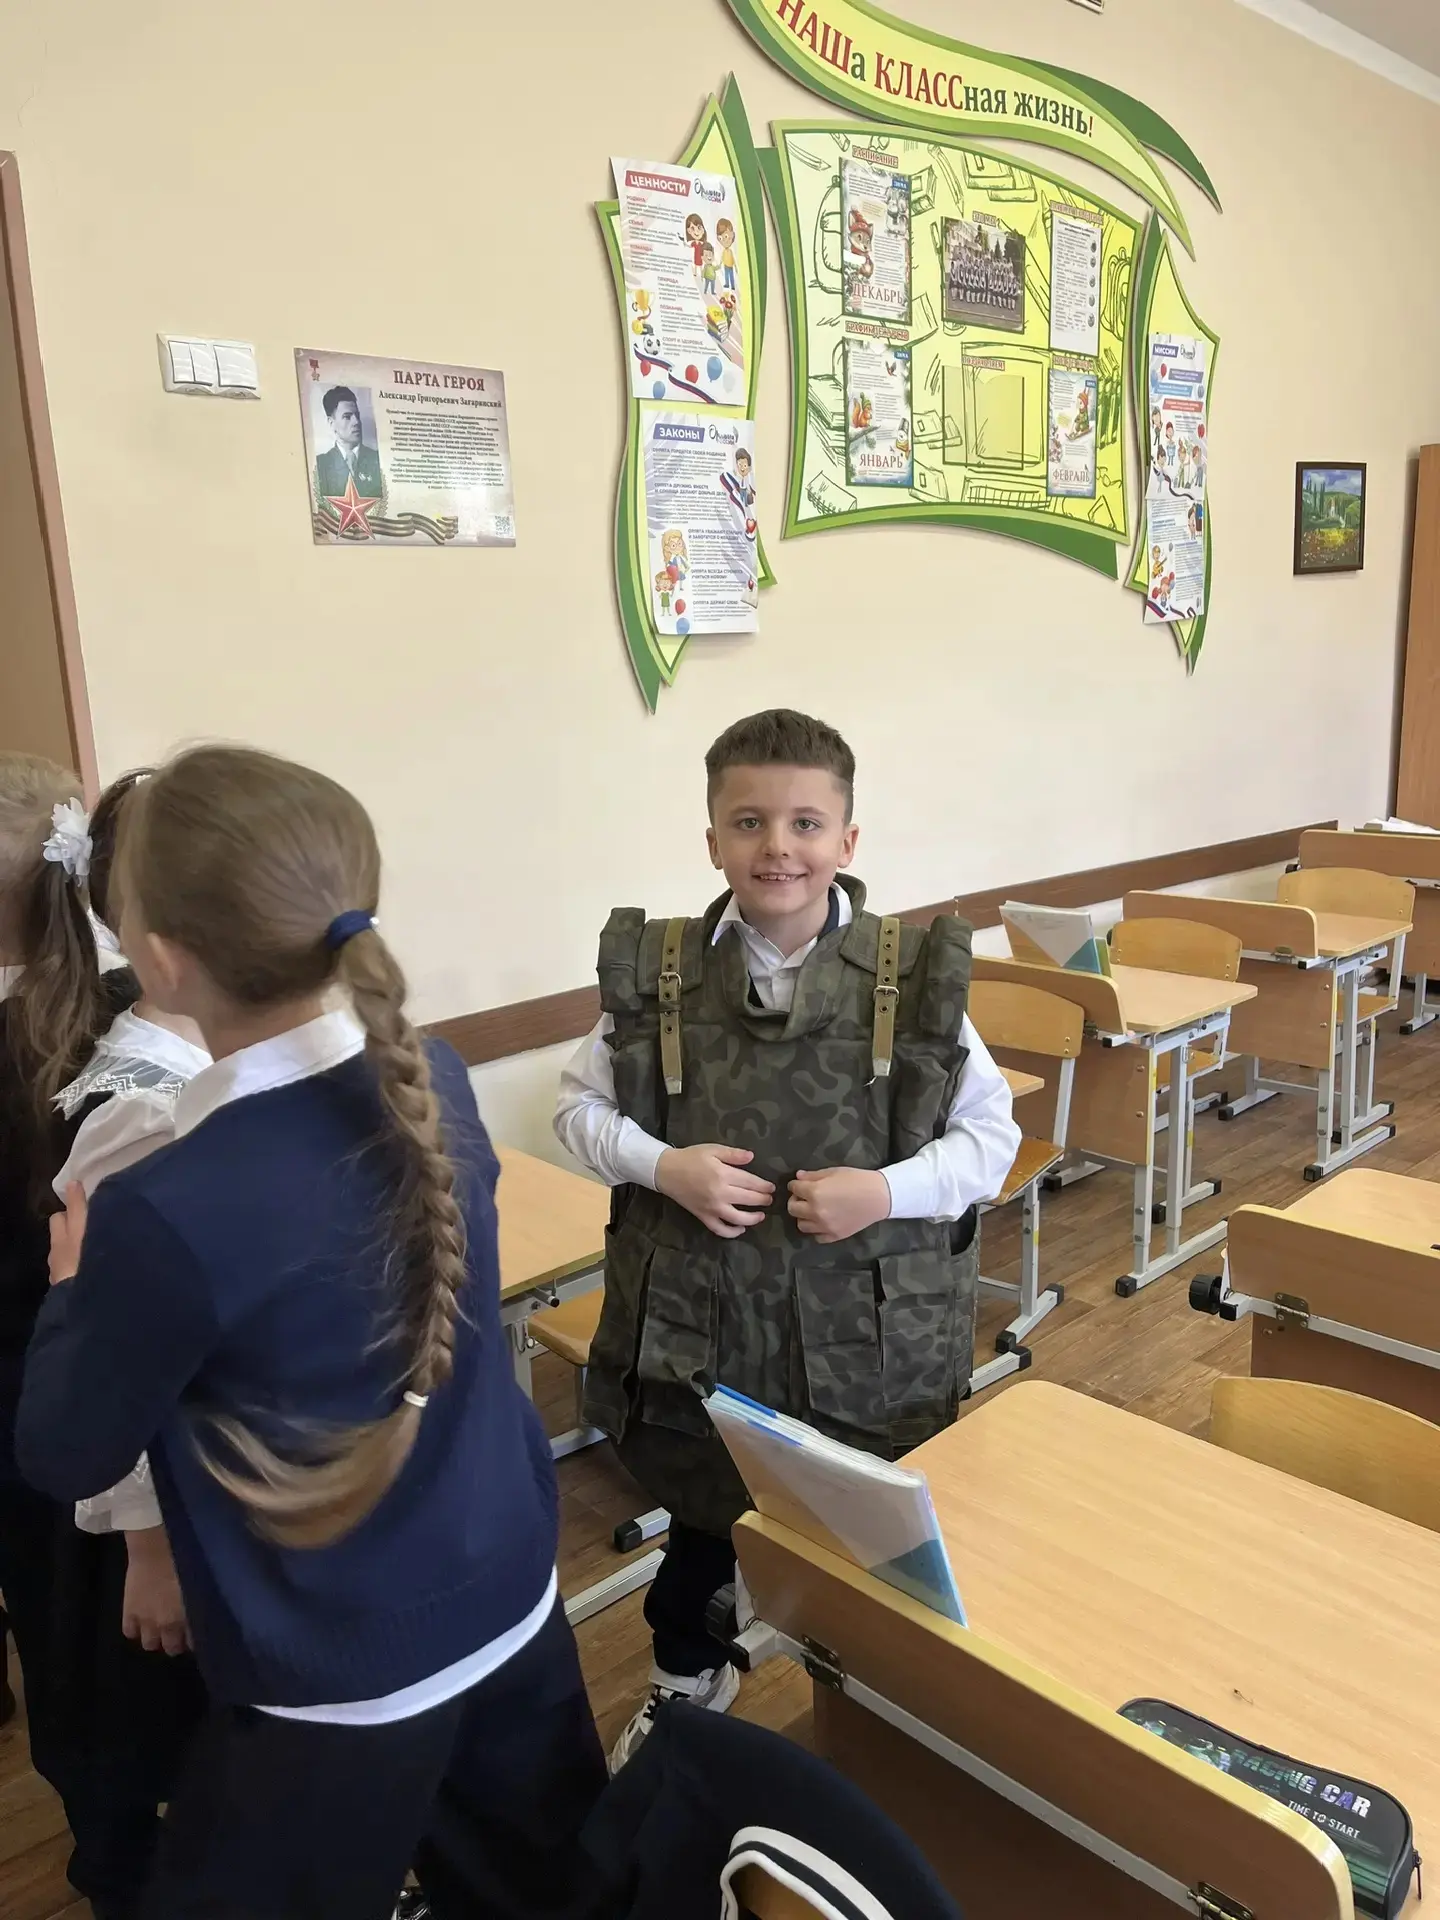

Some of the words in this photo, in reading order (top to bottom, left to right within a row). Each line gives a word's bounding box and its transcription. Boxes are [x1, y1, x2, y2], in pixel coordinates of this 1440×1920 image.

[776, 0, 866, 82] НАШа
[874, 52, 1007, 115] КЛАССная
[1013, 90, 1094, 138] жизнь!
[630, 174, 687, 194] ЦЕННОСТИ
[853, 283, 903, 304] ДЕКАБРЬ
[393, 370, 440, 388] ПАРТА
[443, 375, 485, 391] ГЕРОЯ
[379, 390, 416, 403] Александр
[417, 393, 459, 406] Григорьевич
[659, 427, 700, 440] ЗАКОНЫ
[860, 454, 903, 468] ЯНВАРЬ
[1053, 469, 1090, 482] ФЕВРАЛЬ
[1320, 1784, 1371, 1818] CAR
[1288, 1800, 1310, 1817] TIME
[1313, 1812, 1327, 1823] TO
[1328, 1818, 1360, 1839] START
